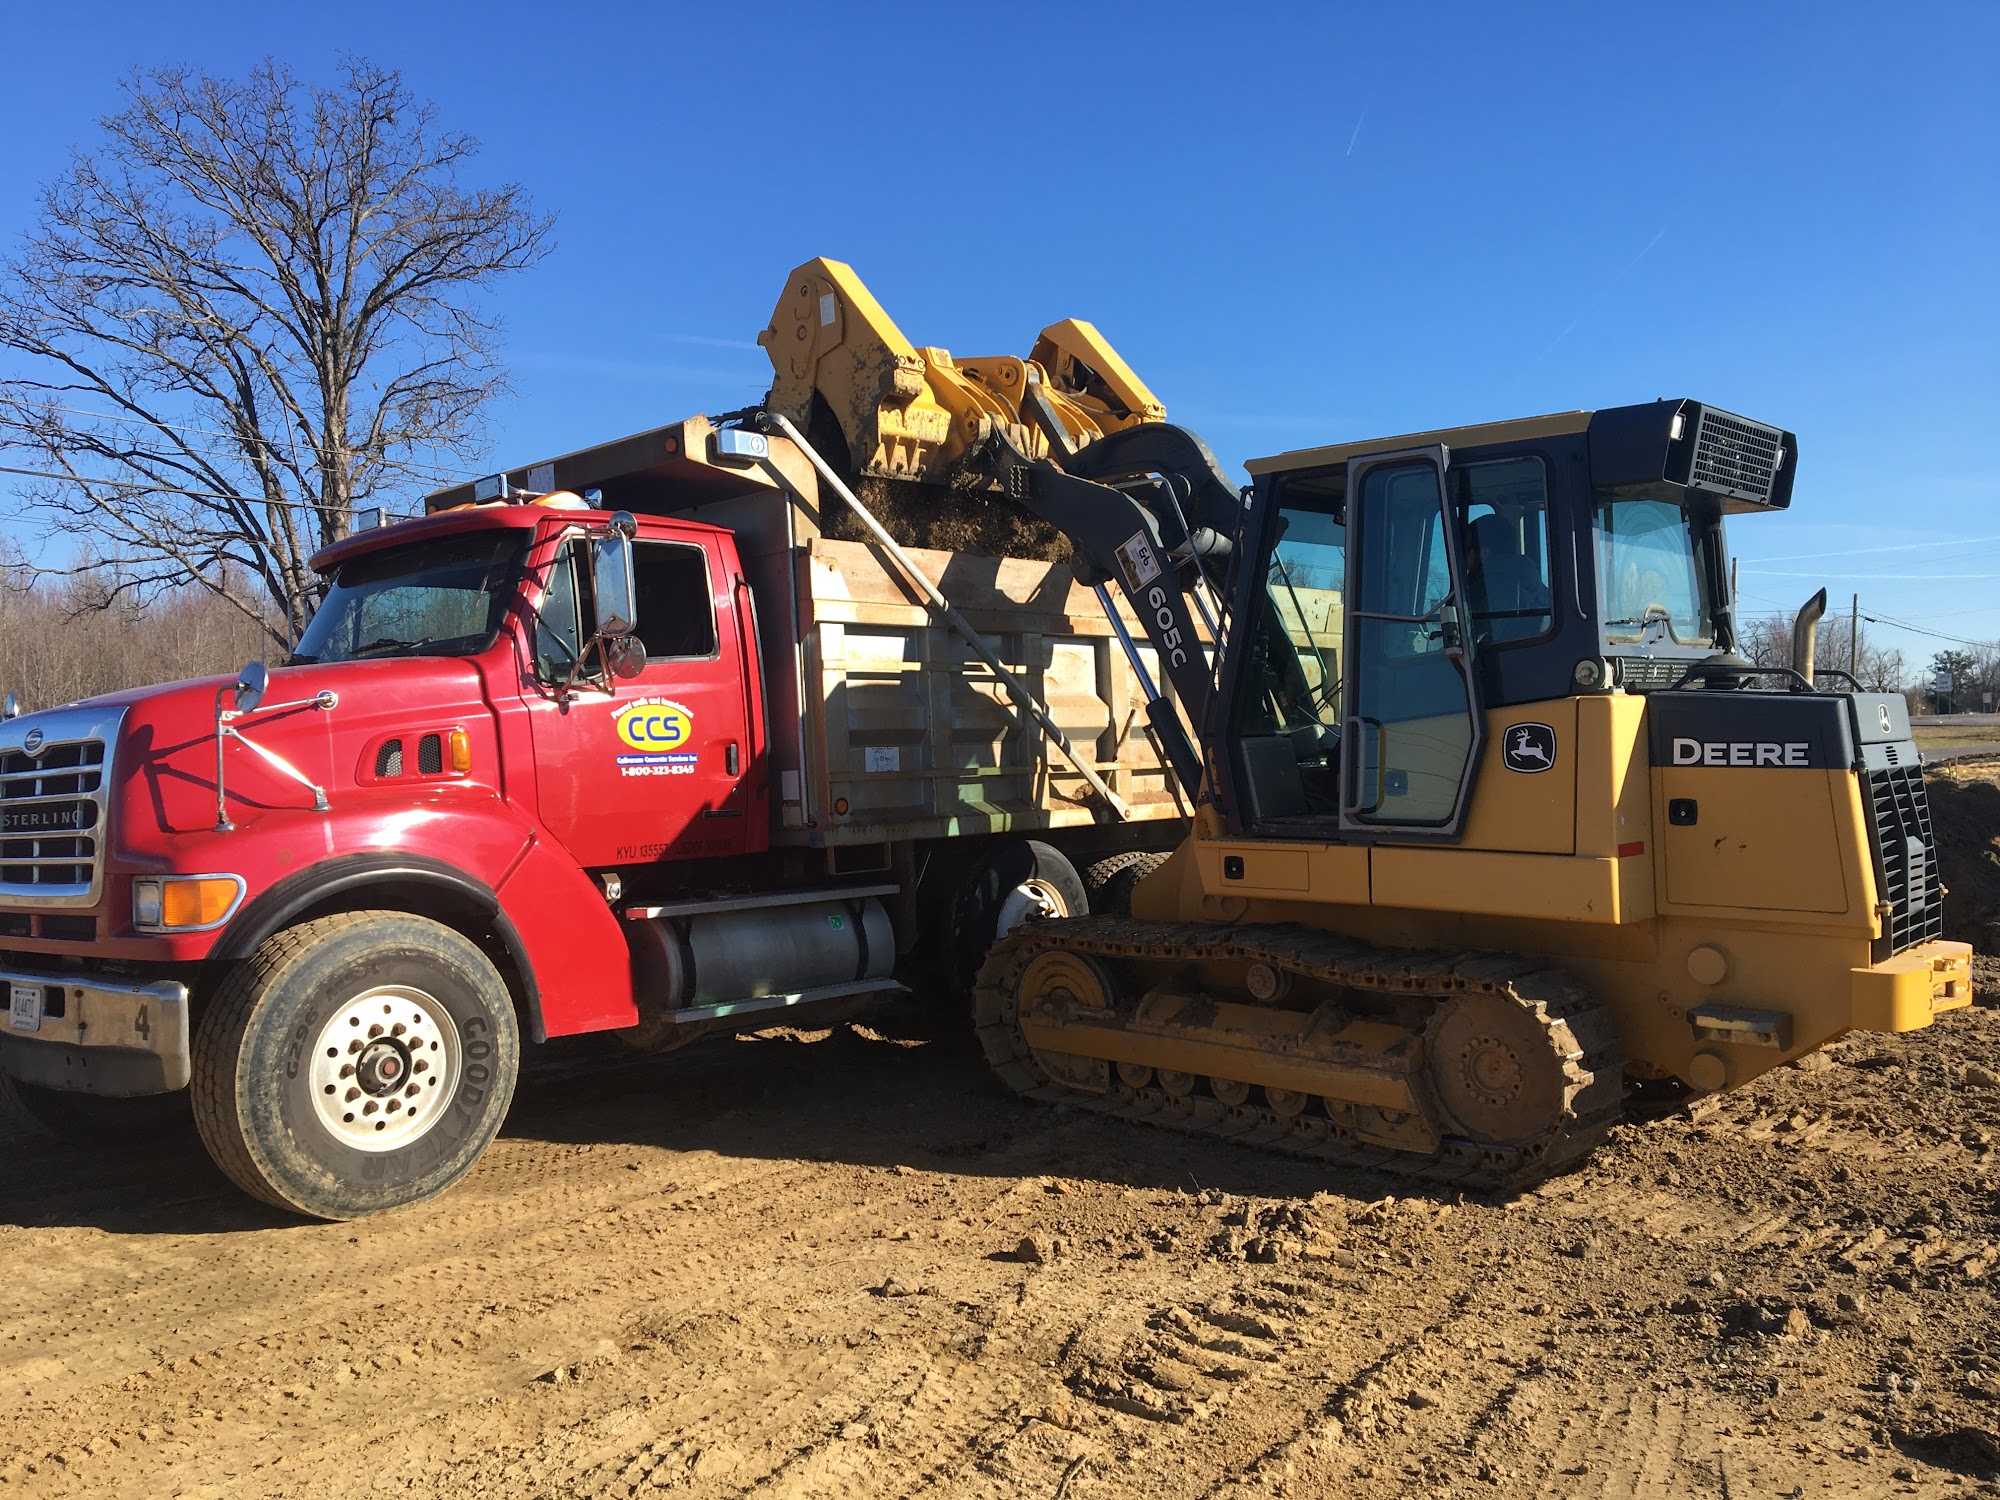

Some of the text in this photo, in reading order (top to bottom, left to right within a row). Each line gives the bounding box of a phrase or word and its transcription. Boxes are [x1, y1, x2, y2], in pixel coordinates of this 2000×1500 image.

[1148, 586, 1188, 669] 605C
[610, 701, 632, 720] Poured
[648, 697, 661, 705] and
[628, 716, 681, 741] CCS
[668, 755, 689, 763] Services
[1673, 737, 1809, 767] DEERE
[621, 764, 695, 777] 1-800-323-8345
[616, 846, 637, 859] KYU
[134, 1003, 151, 1041] 4
[286, 1007, 320, 1080] G296
[362, 1016, 491, 1181] GOODYEAR
